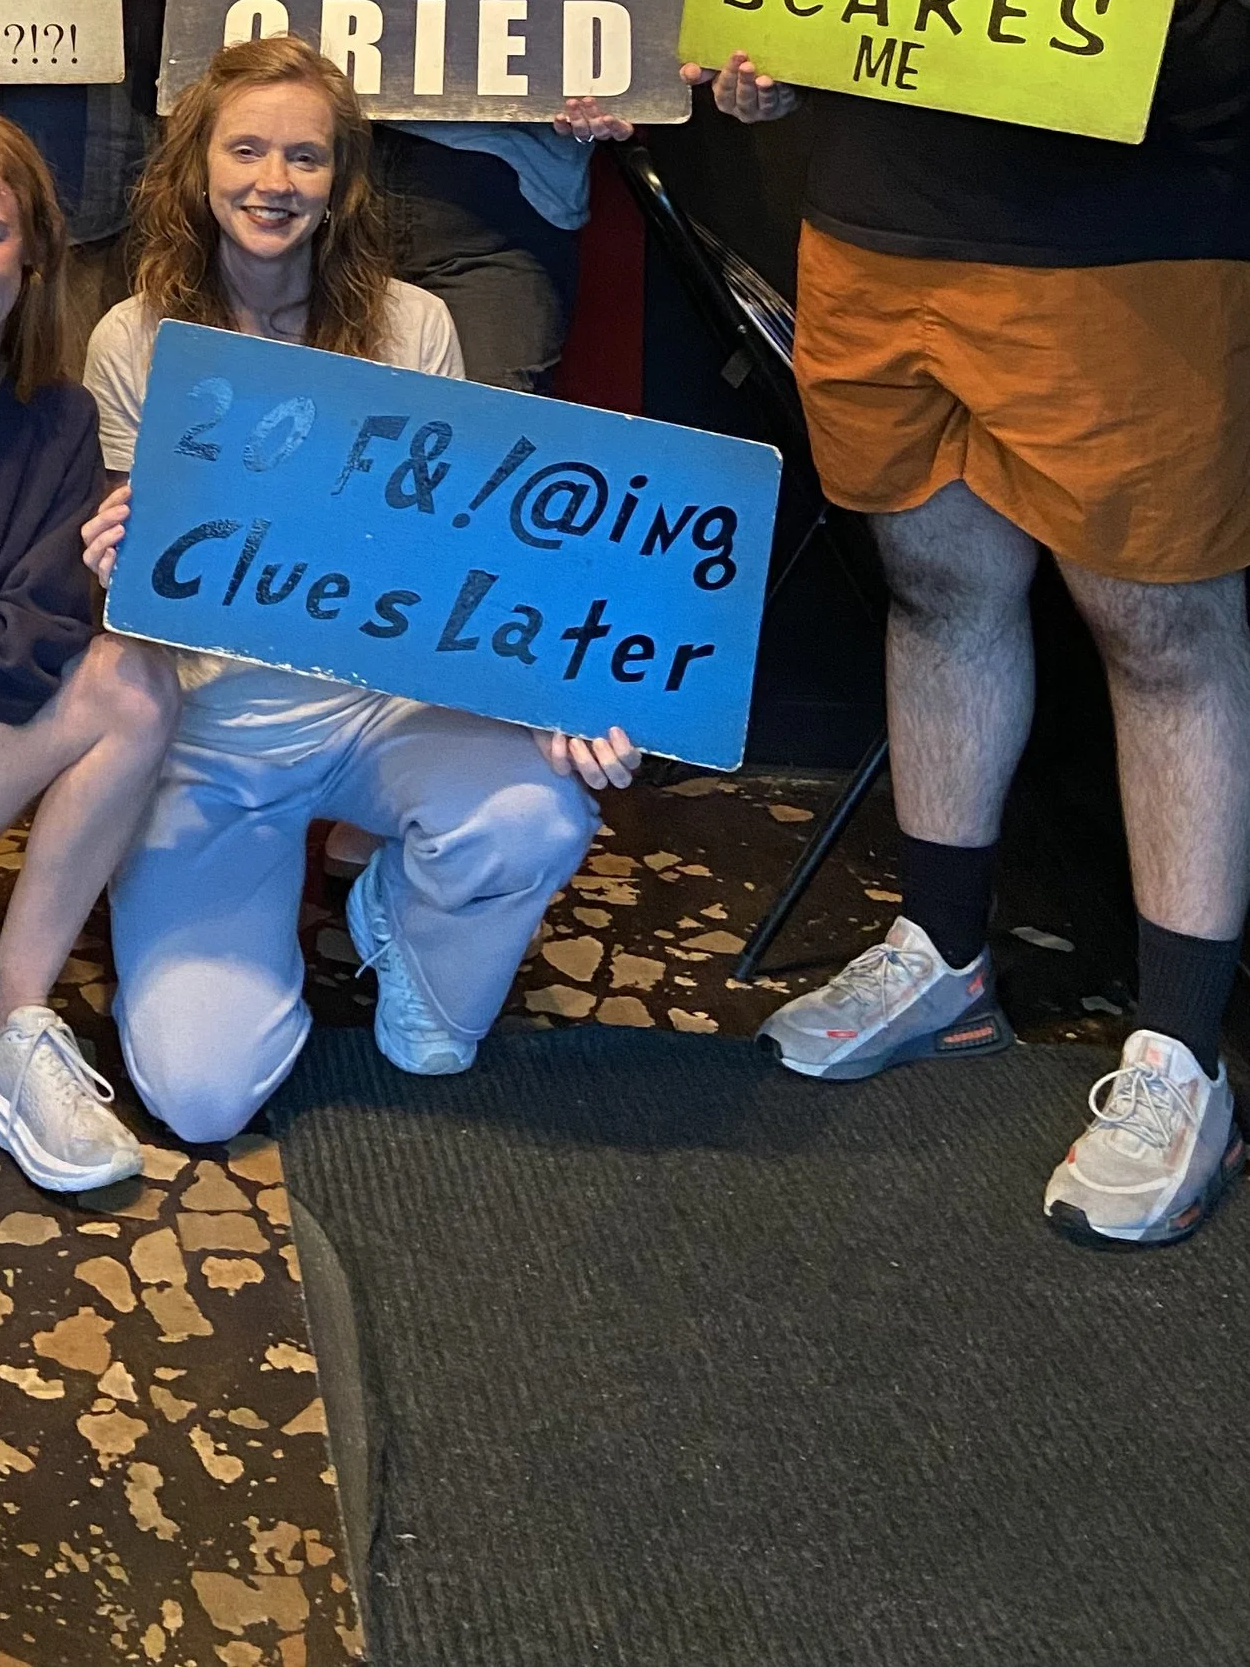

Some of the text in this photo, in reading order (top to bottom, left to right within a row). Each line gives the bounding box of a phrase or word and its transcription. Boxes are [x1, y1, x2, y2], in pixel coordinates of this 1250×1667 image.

[852, 33, 926, 92] ME
[173, 376, 317, 473] 20
[151, 518, 716, 693] Clues Later
